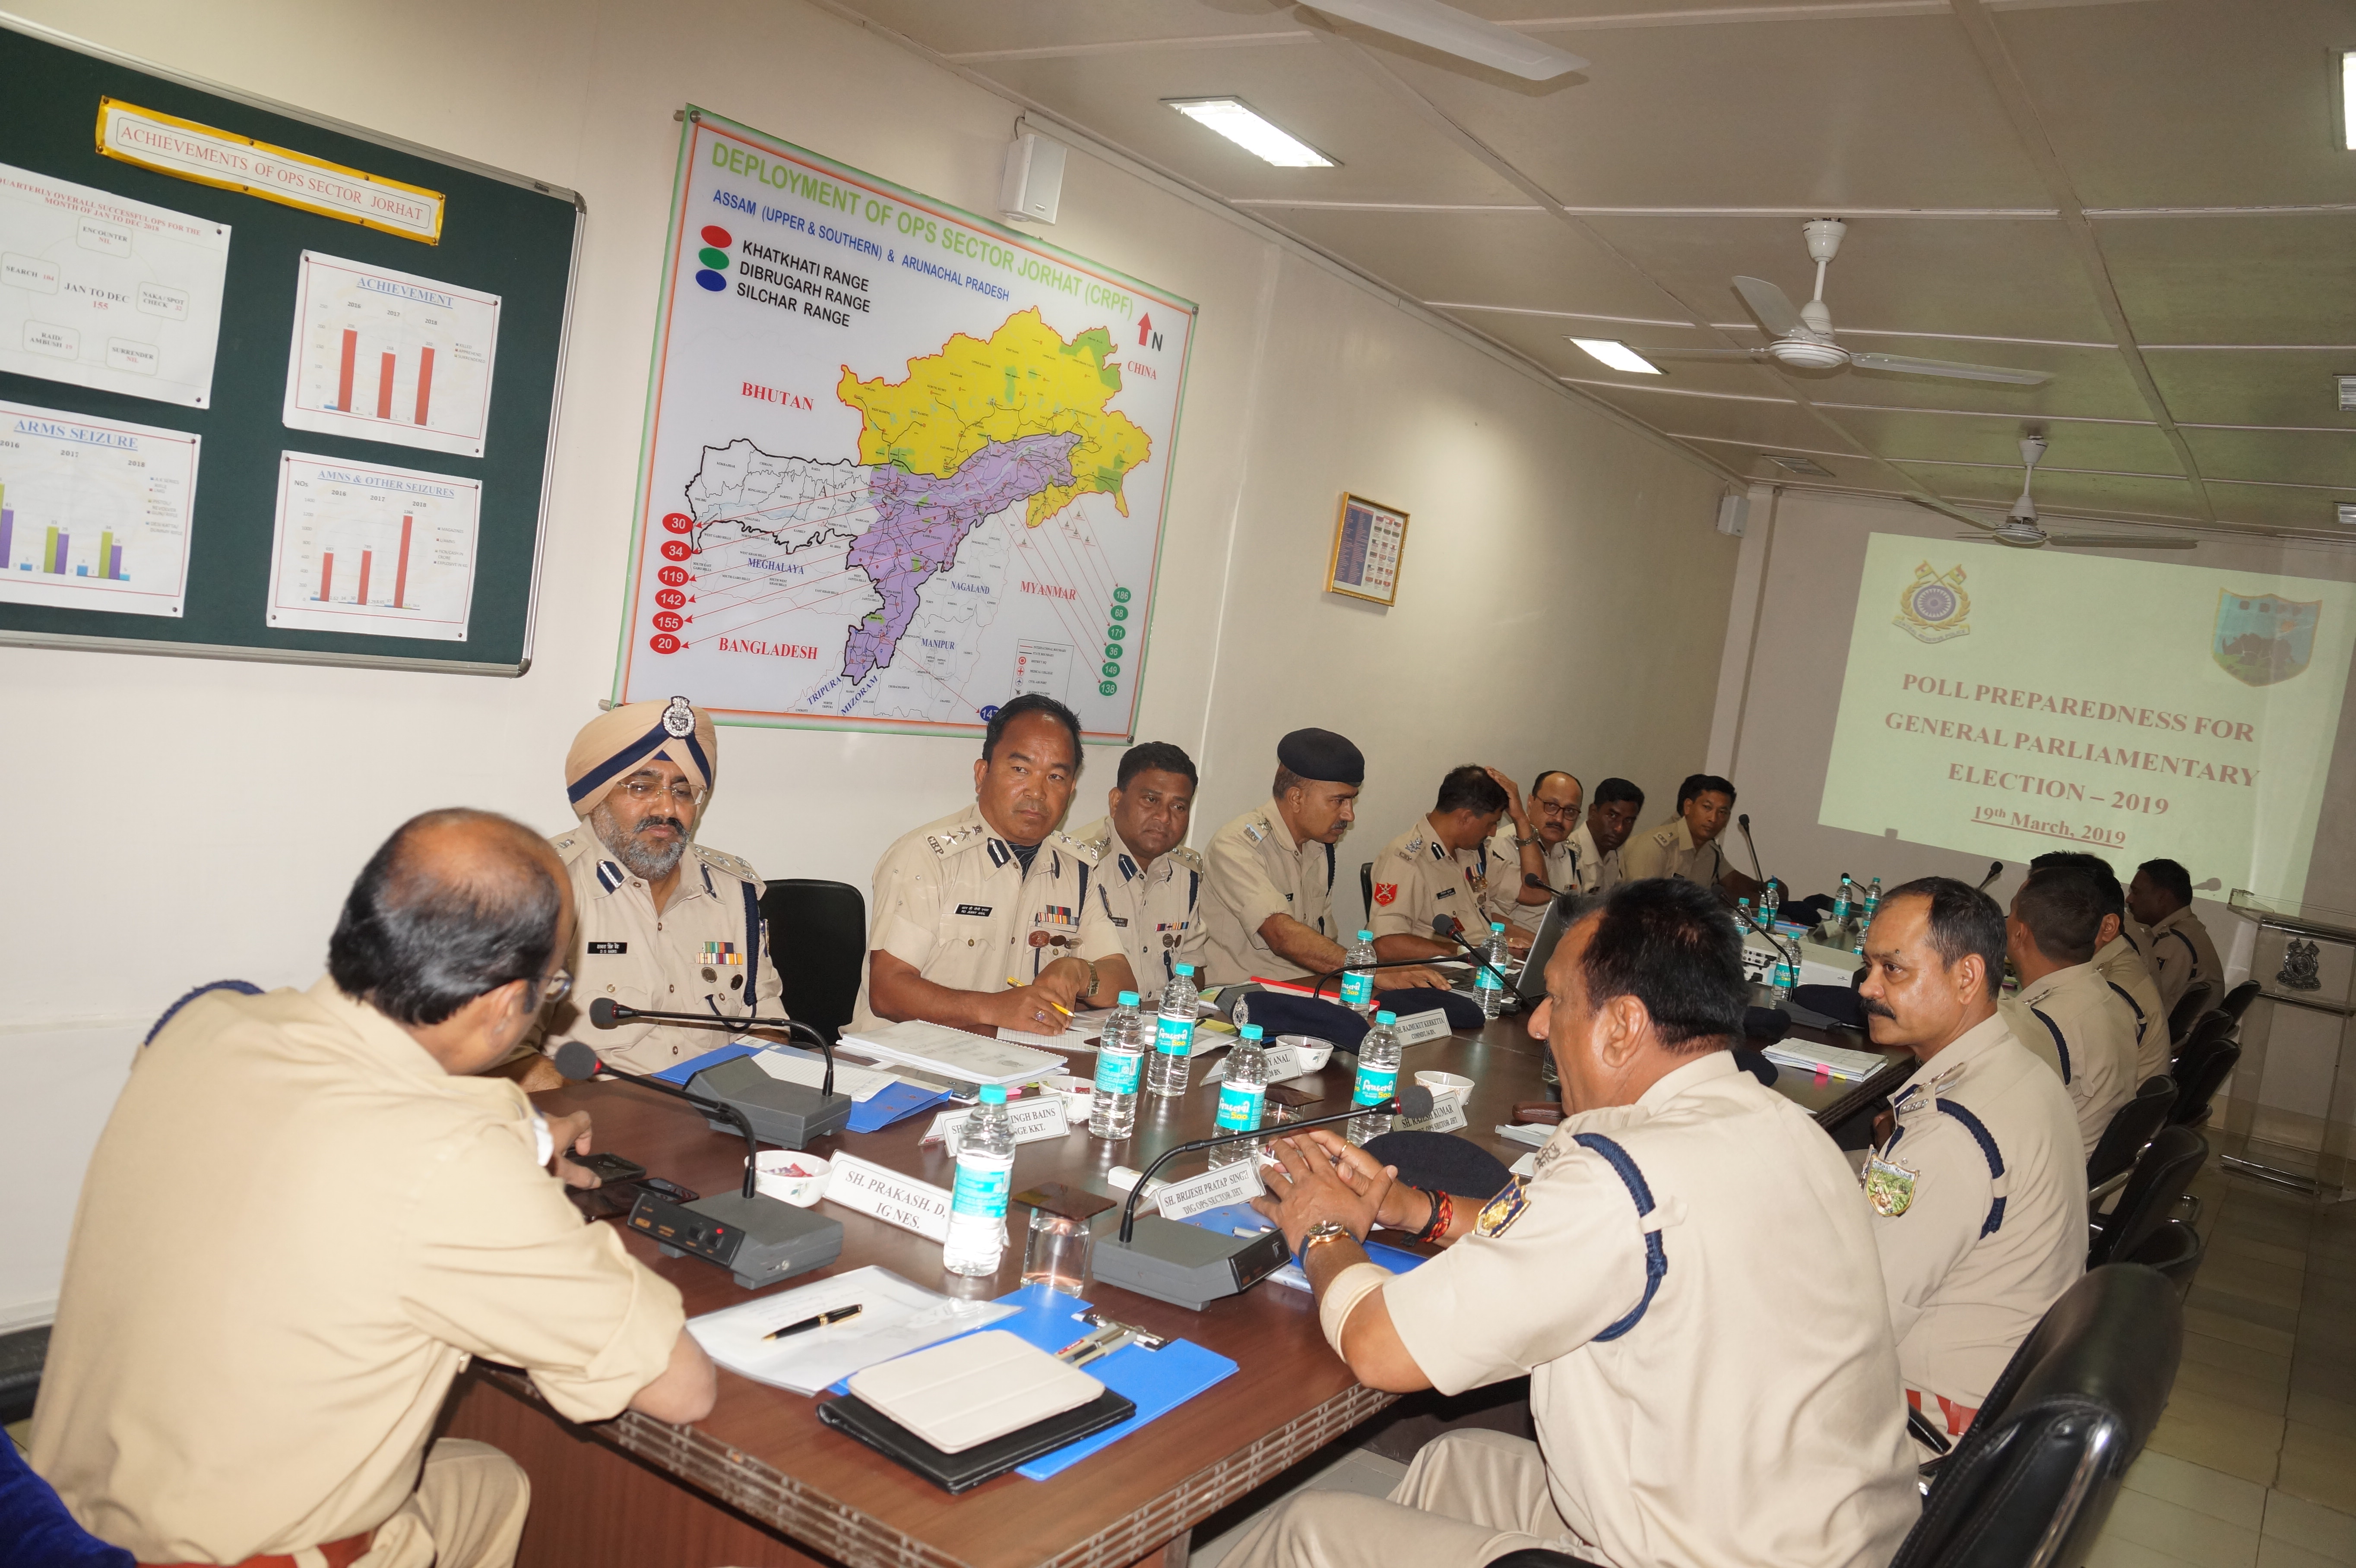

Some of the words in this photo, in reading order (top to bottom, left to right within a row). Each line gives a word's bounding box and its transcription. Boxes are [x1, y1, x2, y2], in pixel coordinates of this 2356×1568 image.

[121, 126, 248, 170] ACHIEVEMENTS
[255, 162, 275, 177] OF
[278, 169, 304, 187] OPS
[308, 178, 362, 204] SECTOR
[371, 196, 423, 220] JORHAT
[44, 197, 78, 211] MONTH
[94, 210, 109, 218] JAN
[126, 218, 142, 227] DEC
[144, 223, 159, 231] 2018
[54, 192, 96, 208] OVERALL
[98, 203, 149, 222] SUCCESSFUL
[151, 218, 166, 227] OPS
[168, 222, 184, 231] FOR
[186, 227, 201, 236] THE
[83, 226, 127, 242] ENCOUNTER
[712, 142, 861, 215] DEPLOYMENT
[865, 199, 893, 226] OF
[897, 211, 937, 243] OPS
[942, 227, 1014, 272] SECTOR
[1017, 257, 1082, 297] JORHAT
[1085, 282, 1133, 321] (CRPF)
[712, 189, 757, 215] ASSAM
[762, 205, 805, 232] (UPPER
[808, 221, 816, 236] &
[818, 225, 882, 261] SOUTHERN)
[887, 249, 895, 263] &
[902, 254, 963, 286] ARUNACHAL
[966, 276, 1010, 302] PRADESH
[6, 266, 38, 278] SEARCH
[743, 240, 820, 277] KHATKHATI
[823, 266, 869, 292] RANGE
[64, 282, 86, 294] JAN
[89, 287, 104, 297] TO
[108, 292, 130, 303] DEC
[357, 277, 454, 307] ACHIEVEMENT
[740, 261, 822, 298] DIBRUGARH
[825, 288, 871, 313] RANGE
[93, 301, 108, 310] 155
[143, 298, 168, 308] CHECK
[736, 282, 797, 312] SILCHAR
[804, 302, 850, 328] RANGE
[30, 337, 62, 348] AMBUSH
[1151, 331, 1163, 351] N
[112, 347, 154, 360] SURRENDER
[1127, 360, 1157, 381] CHINA
[741, 381, 814, 411] BHUTAN
[14, 420, 66, 437] ARMS
[70, 428, 139, 449] SEIZURE
[0, 440, 20, 449] 2016
[60, 449, 79, 458] 2017
[318, 470, 350, 482] AMNS
[352, 475, 362, 483] &
[365, 477, 403, 490] OTHER
[406, 483, 455, 497] SEIZURES
[671, 518, 686, 529] 30
[668, 545, 683, 557] 34
[747, 557, 804, 575] MEGHALAYA
[662, 571, 684, 583] 119
[950, 581, 990, 595] NAGALAND
[1020, 581, 1077, 601] MYANMAR
[1116, 591, 1128, 600] 186
[660, 593, 682, 605] 142
[657, 616, 679, 629] 155
[1115, 609, 1123, 617] 68
[1111, 629, 1123, 638] 171
[658, 638, 672, 649] 20
[718, 637, 818, 660] BANGLADESH
[921, 638, 955, 650] MANIPUR
[1109, 647, 1118, 656] 36
[1105, 665, 1117, 674] 149
[807, 676, 842, 706] TRIPURA
[840, 675, 878, 717] MIZORAM
[1101, 684, 1115, 693] 138
[1902, 673, 1970, 702] POLL
[1976, 684, 2187, 733] PREPAREDNESS
[2194, 716, 2255, 743] FOR
[1884, 711, 2009, 749] GENERAL
[2014, 732, 2261, 788] PARLIAMENTARY
[1947, 762, 2085, 803] ELECTION
[2111, 790, 2169, 816] 2019
[1973, 805, 2007, 822] 19th
[2011, 811, 2074, 838] March,
[2080, 824, 2127, 846] 2019
[1424, 1018, 1444, 1027] KERKETTA
[1273, 1054, 1290, 1065] ANAL
[1009, 1112, 1031, 1124] INGH
[1032, 1108, 1056, 1121] BAINS
[1230, 1112, 1248, 1120] 500
[1401, 1118, 1412, 1129] SH.
[1433, 1104, 1454, 1119] KUMAR
[1434, 1119, 1450, 1129] SECTOR
[1014, 1126, 1028, 1135] NGE
[1029, 1123, 1046, 1132] KKT.
[845, 1170, 864, 1188] SH.
[867, 1179, 930, 1212] PRAKASH.
[933, 1203, 945, 1219] D,
[1164, 1196, 1176, 1207] SH.
[1176, 1186, 1204, 1204] BRIJESH
[1204, 1177, 1228, 1195] PRATAP
[1230, 1170, 1250, 1185] SINGH
[1182, 1204, 1196, 1215] DIG
[1196, 1200, 1209, 1210] OPS
[1208, 1192, 1230, 1206] SECTOR
[874, 1202, 890, 1218] IG
[893, 1211, 920, 1229] NES.
